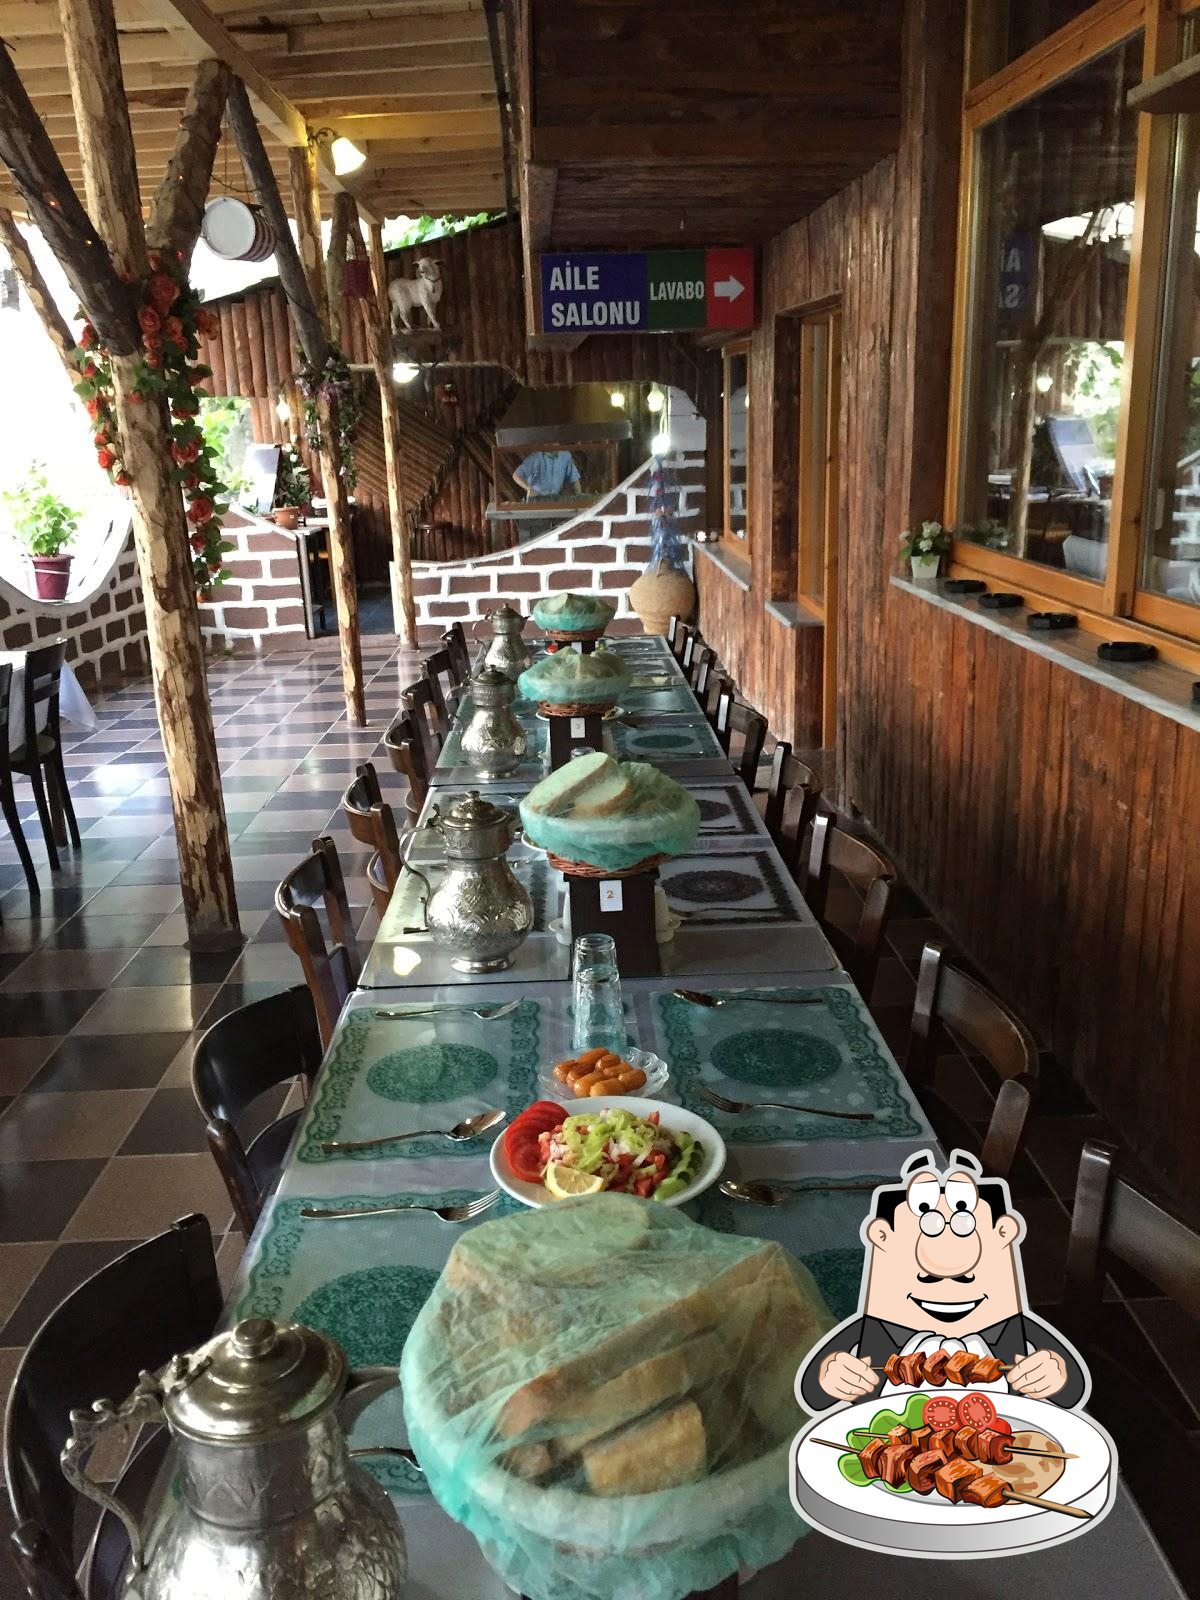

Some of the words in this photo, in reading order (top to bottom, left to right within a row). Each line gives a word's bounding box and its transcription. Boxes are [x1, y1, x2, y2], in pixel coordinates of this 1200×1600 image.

[549, 260, 600, 292] AİLE
[649, 280, 705, 301] LAVABO
[551, 300, 641, 328] SALONU
